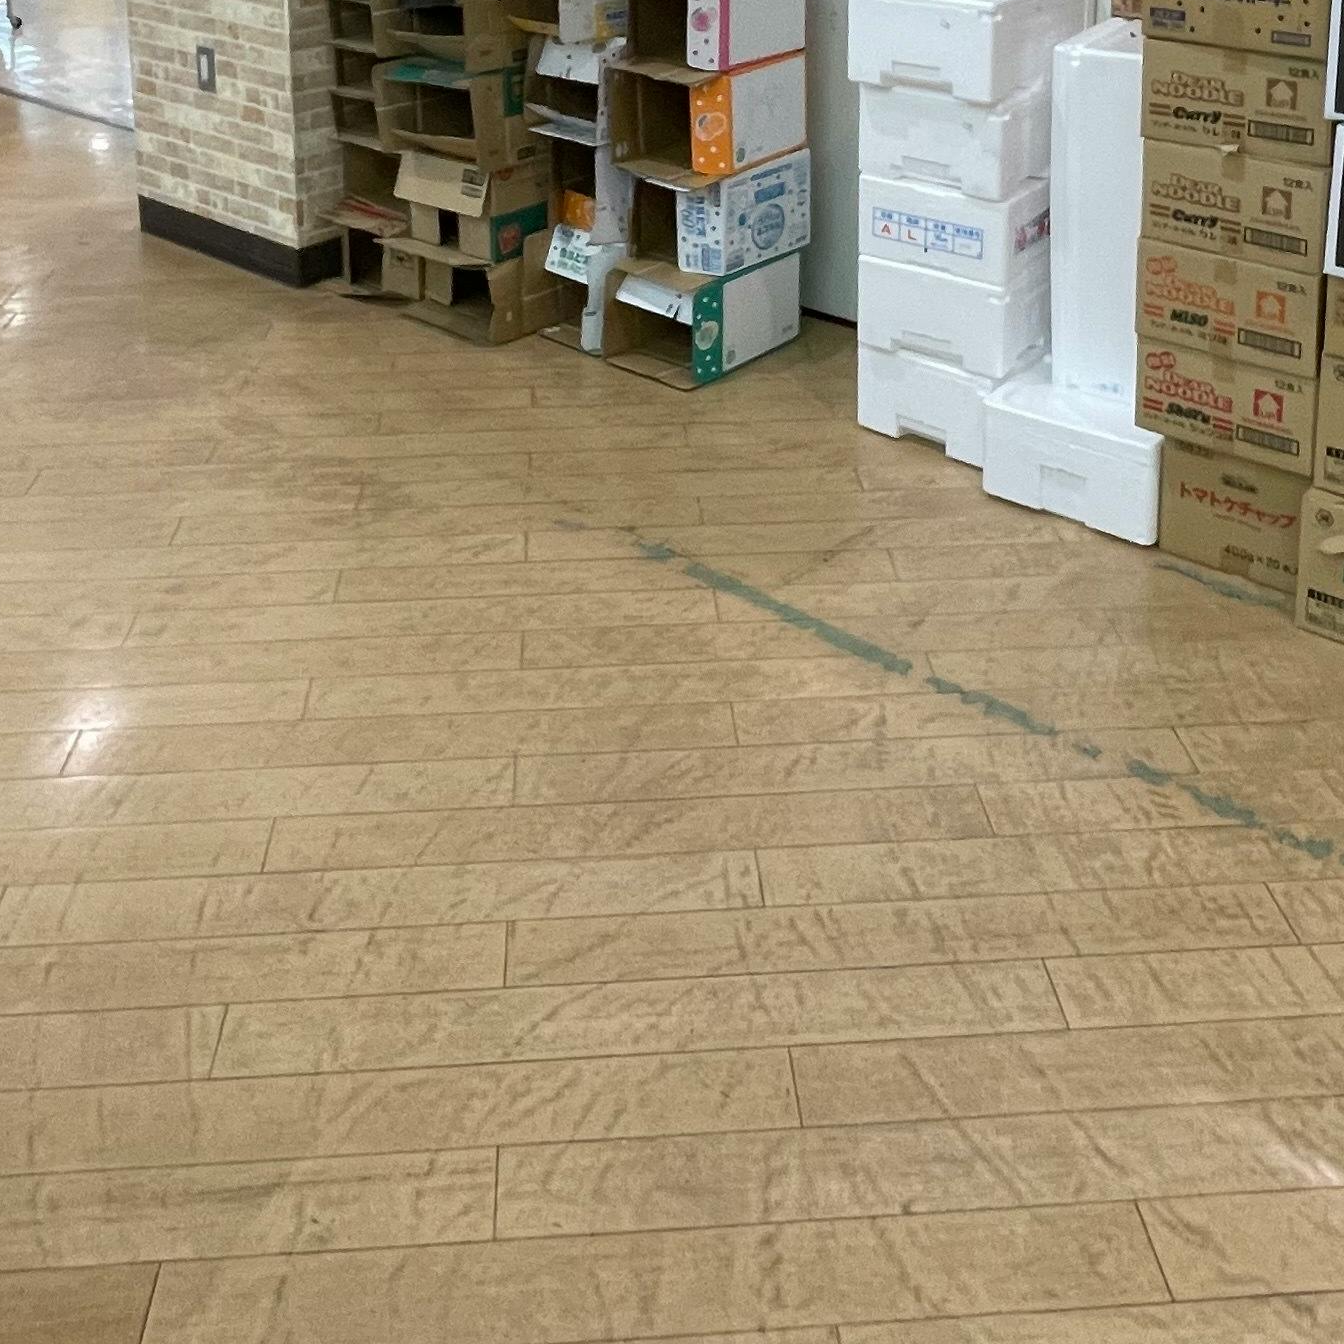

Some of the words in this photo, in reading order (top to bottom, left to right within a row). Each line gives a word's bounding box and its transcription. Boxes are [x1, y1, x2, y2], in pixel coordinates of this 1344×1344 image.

[881, 223, 892, 235] A
[907, 229, 917, 241] L
[1179, 480, 1297, 529] トマトケチャップ
